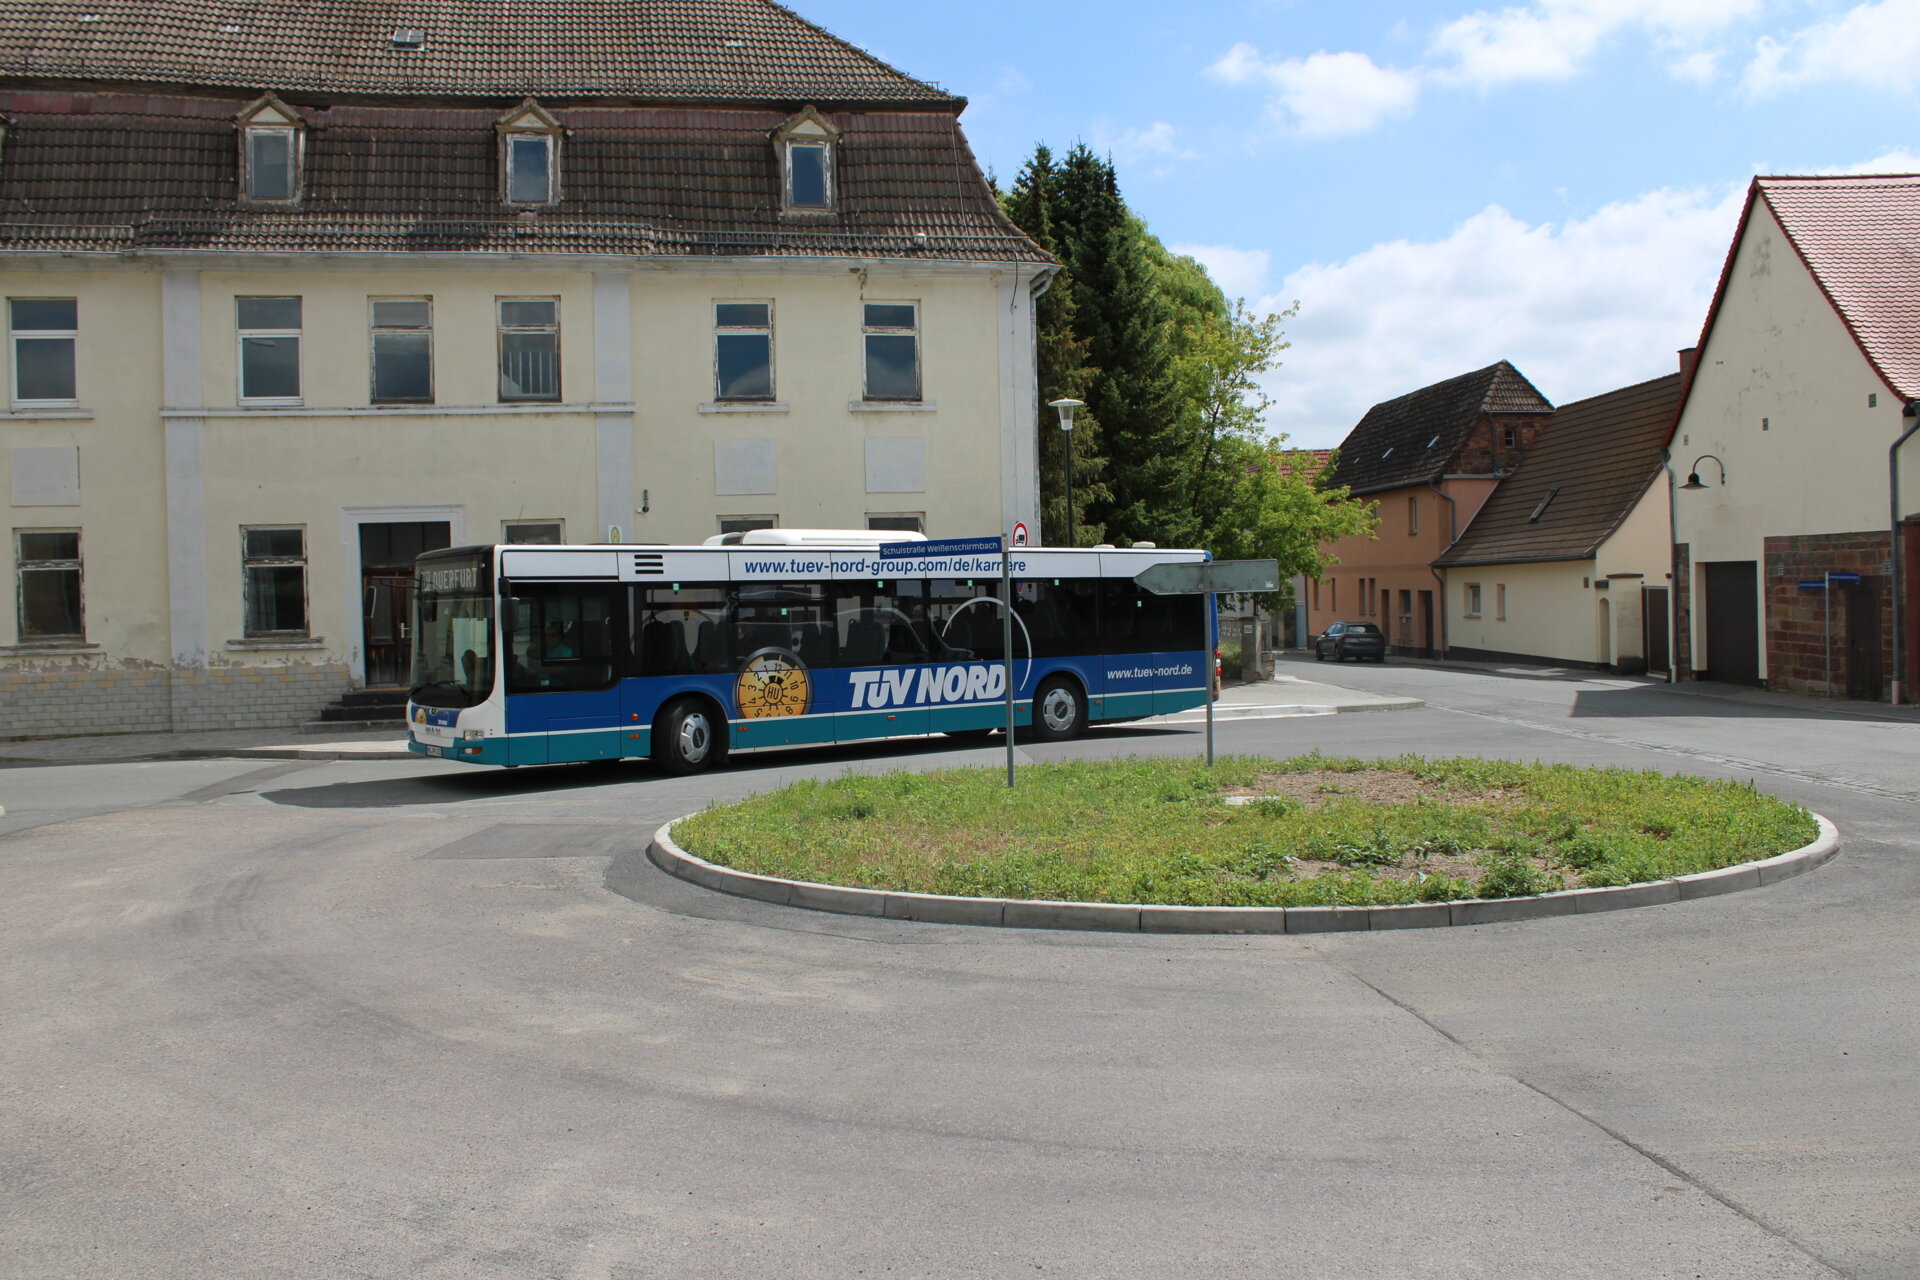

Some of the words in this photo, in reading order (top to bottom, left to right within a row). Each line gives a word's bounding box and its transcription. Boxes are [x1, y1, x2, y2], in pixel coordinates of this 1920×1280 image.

[883, 545, 926, 556] Schulstraße
[927, 541, 998, 553] Weißenschirmbach
[745, 558, 1026, 576] www.tuev-nord-group.com/de/karrere
[432, 568, 478, 590] QUERFURT
[774, 663, 782, 674] 12
[1107, 664, 1193, 679] www.tuev-nord.de
[753, 672, 762, 681] 2
[789, 680, 799, 690] 10
[849, 668, 916, 708] TÜV
[916, 664, 1006, 704] NORD
[767, 686, 780, 700] HU
[785, 706, 793, 715] 8
